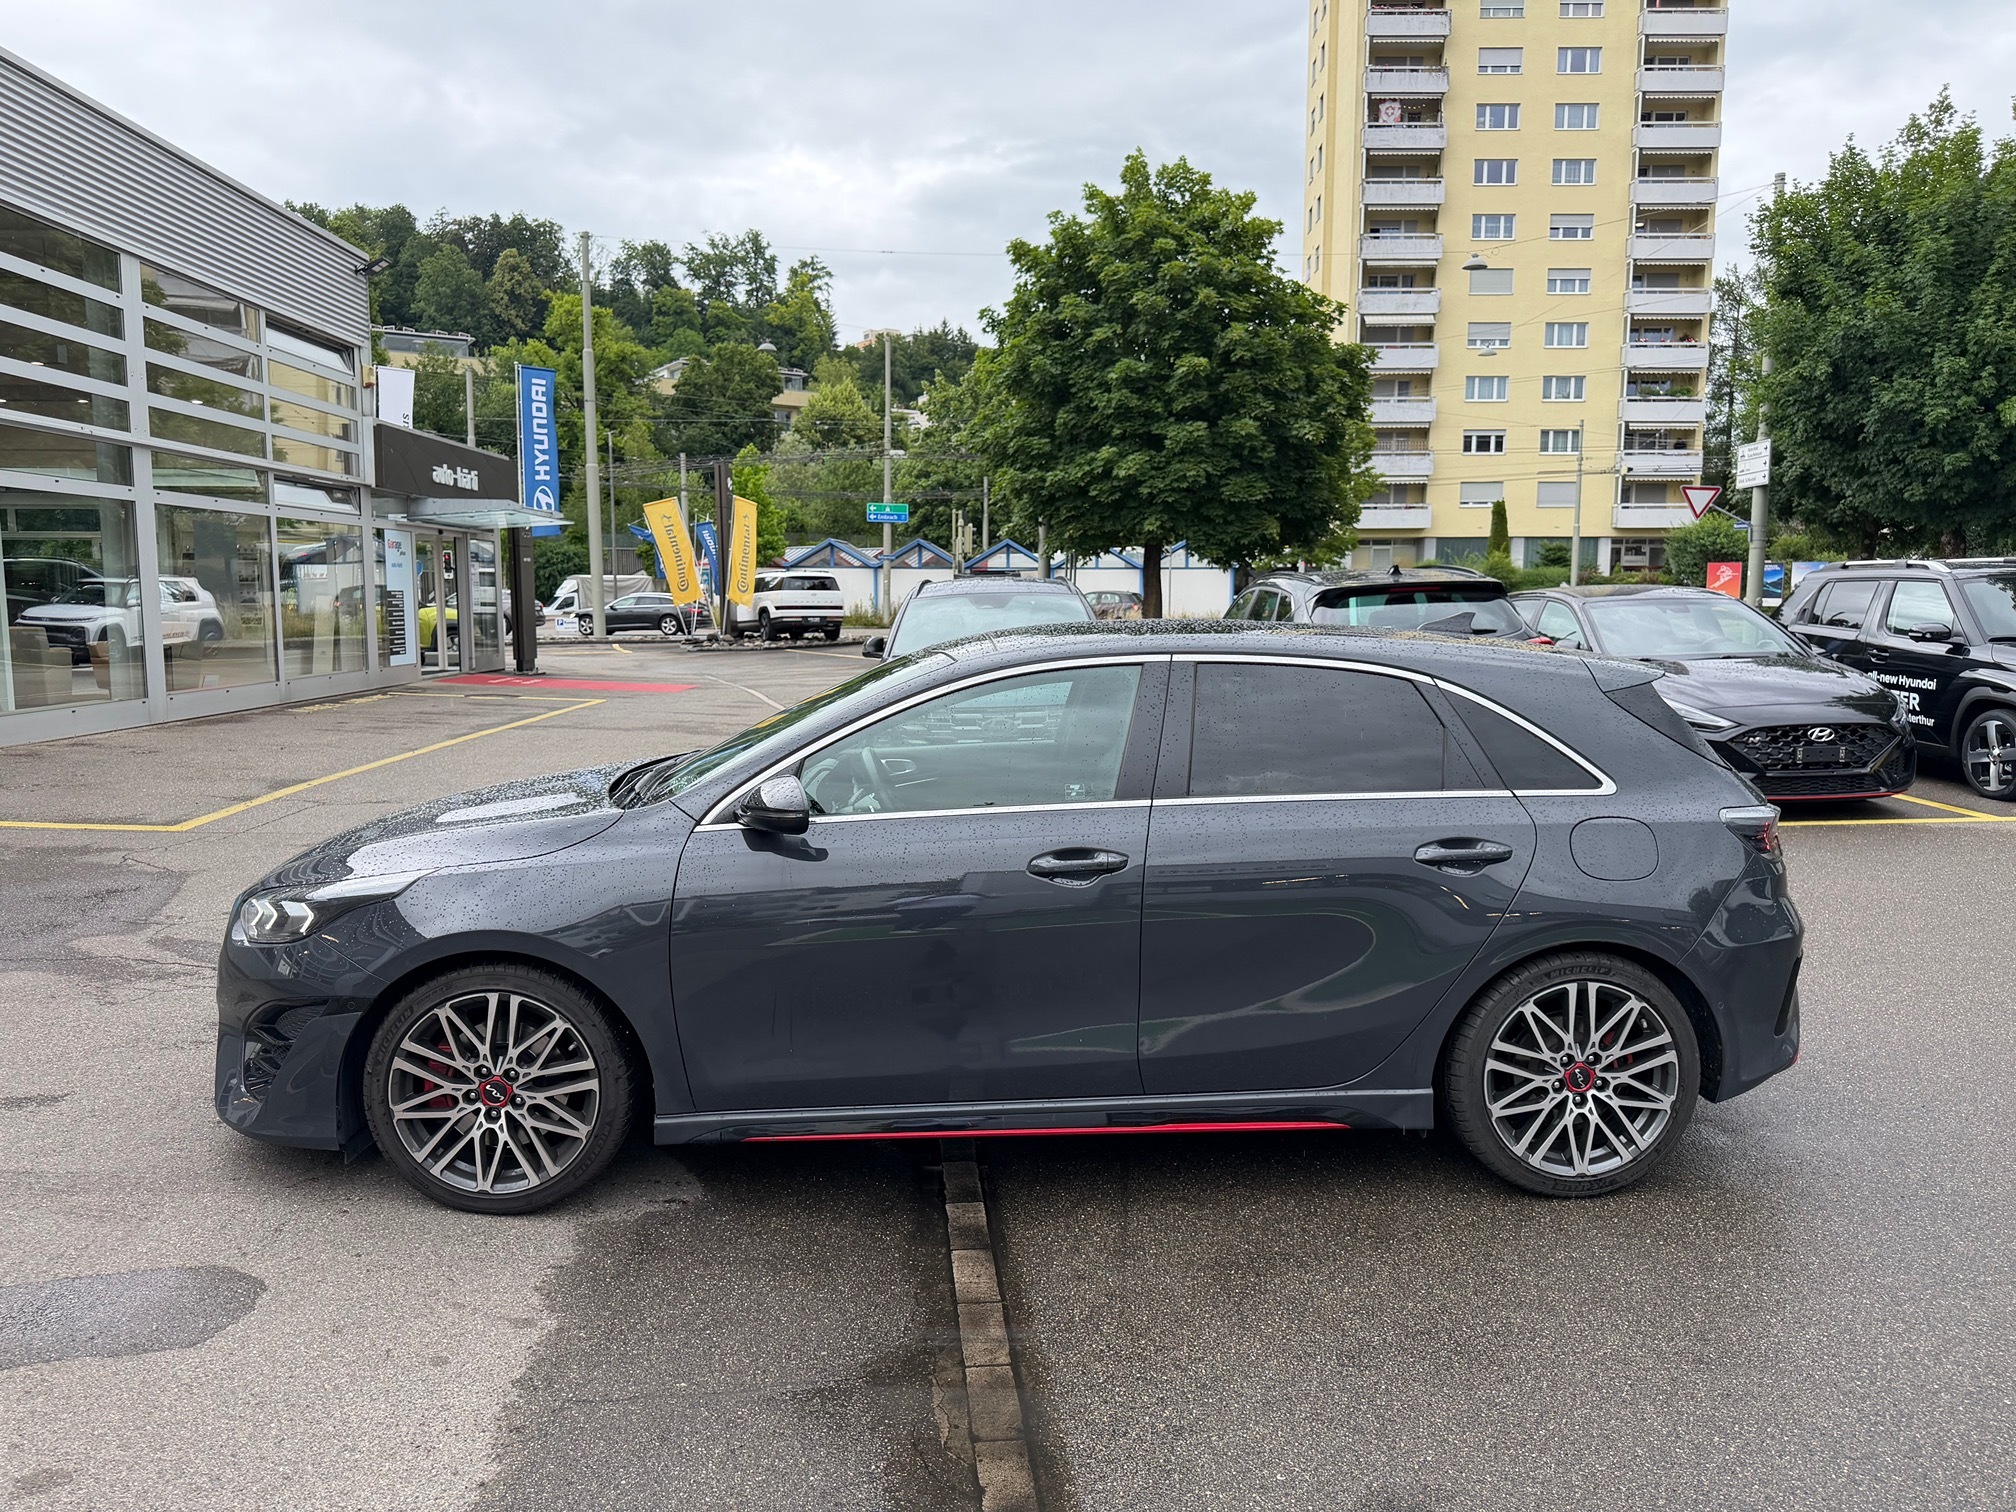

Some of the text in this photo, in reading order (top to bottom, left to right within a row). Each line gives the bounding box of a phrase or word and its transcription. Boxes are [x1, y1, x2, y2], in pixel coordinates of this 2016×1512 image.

[531, 378, 550, 480] HYUNDAI
[737, 523, 751, 593] Continental
[1898, 674, 1937, 691] Hyundai
[376, 1006, 413, 1062] MICHELIN
